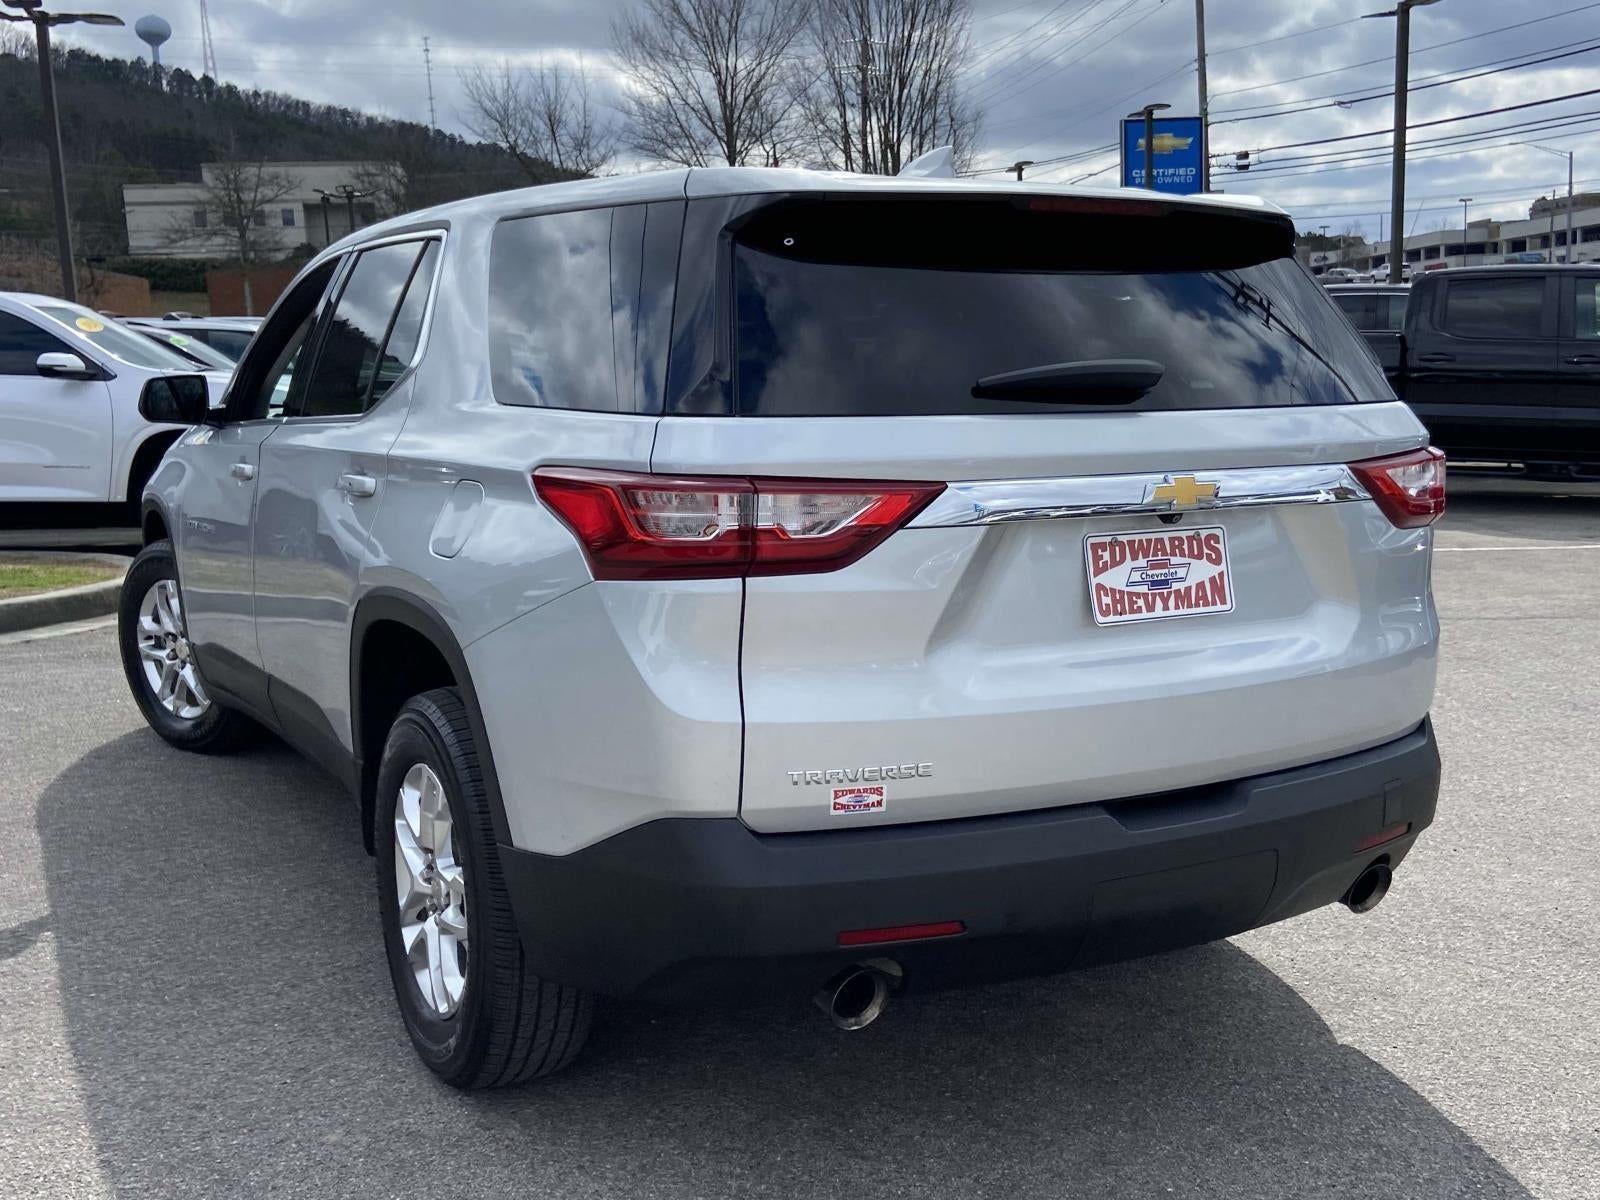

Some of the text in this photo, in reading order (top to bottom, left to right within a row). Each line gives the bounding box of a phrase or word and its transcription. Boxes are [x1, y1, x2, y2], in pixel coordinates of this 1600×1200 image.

[1135, 176, 1193, 184] P-OWNED
[1090, 532, 1223, 578] EDWARDS
[1140, 570, 1178, 580] Chevrolet
[1094, 571, 1228, 618] CHEVYMAN
[787, 762, 934, 786] TRAVERSE
[833, 786, 883, 800] EDWARDS
[833, 798, 883, 811] CHEVYMAN
